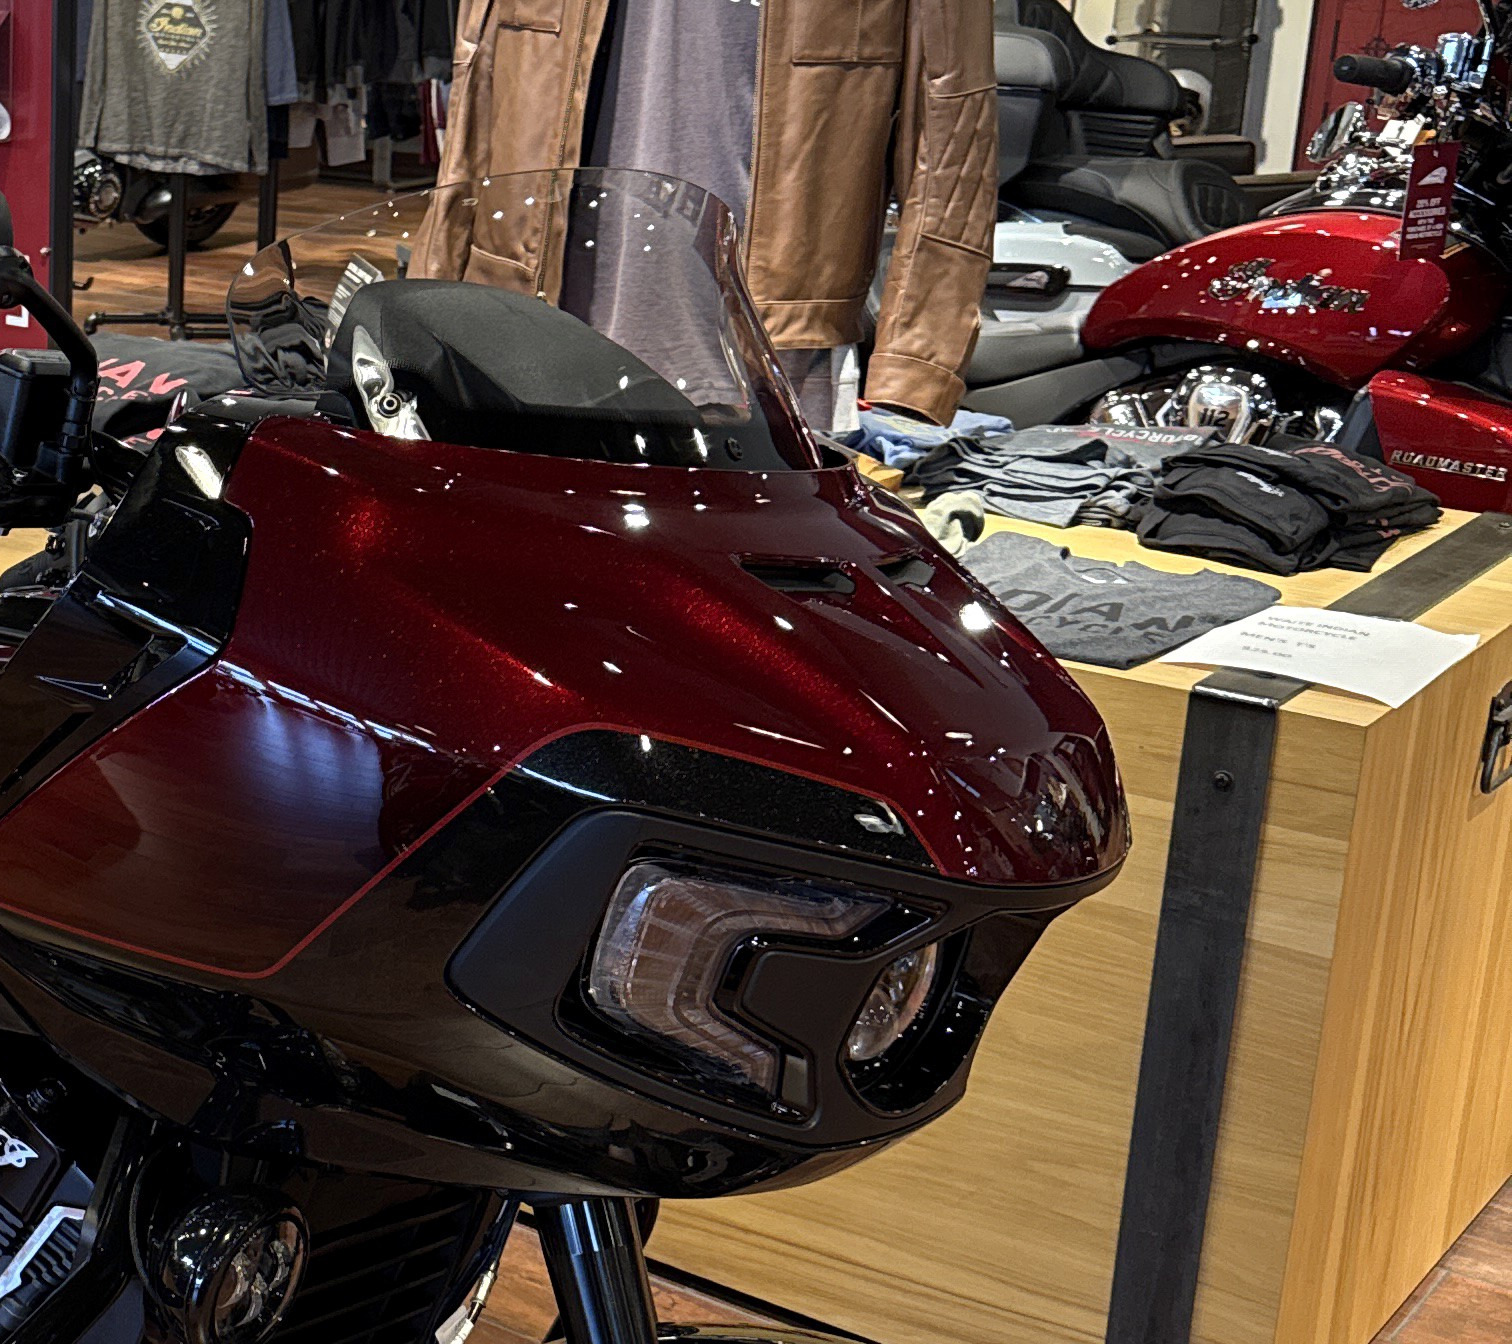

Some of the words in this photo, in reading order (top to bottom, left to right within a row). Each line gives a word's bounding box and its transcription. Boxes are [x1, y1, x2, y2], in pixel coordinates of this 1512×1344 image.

[1198, 408, 1232, 428] 112
[1390, 449, 1509, 481] ROADMASTER
[1257, 621, 1358, 641] MOTORCYCLE
[1317, 623, 1371, 637] INDIAN
